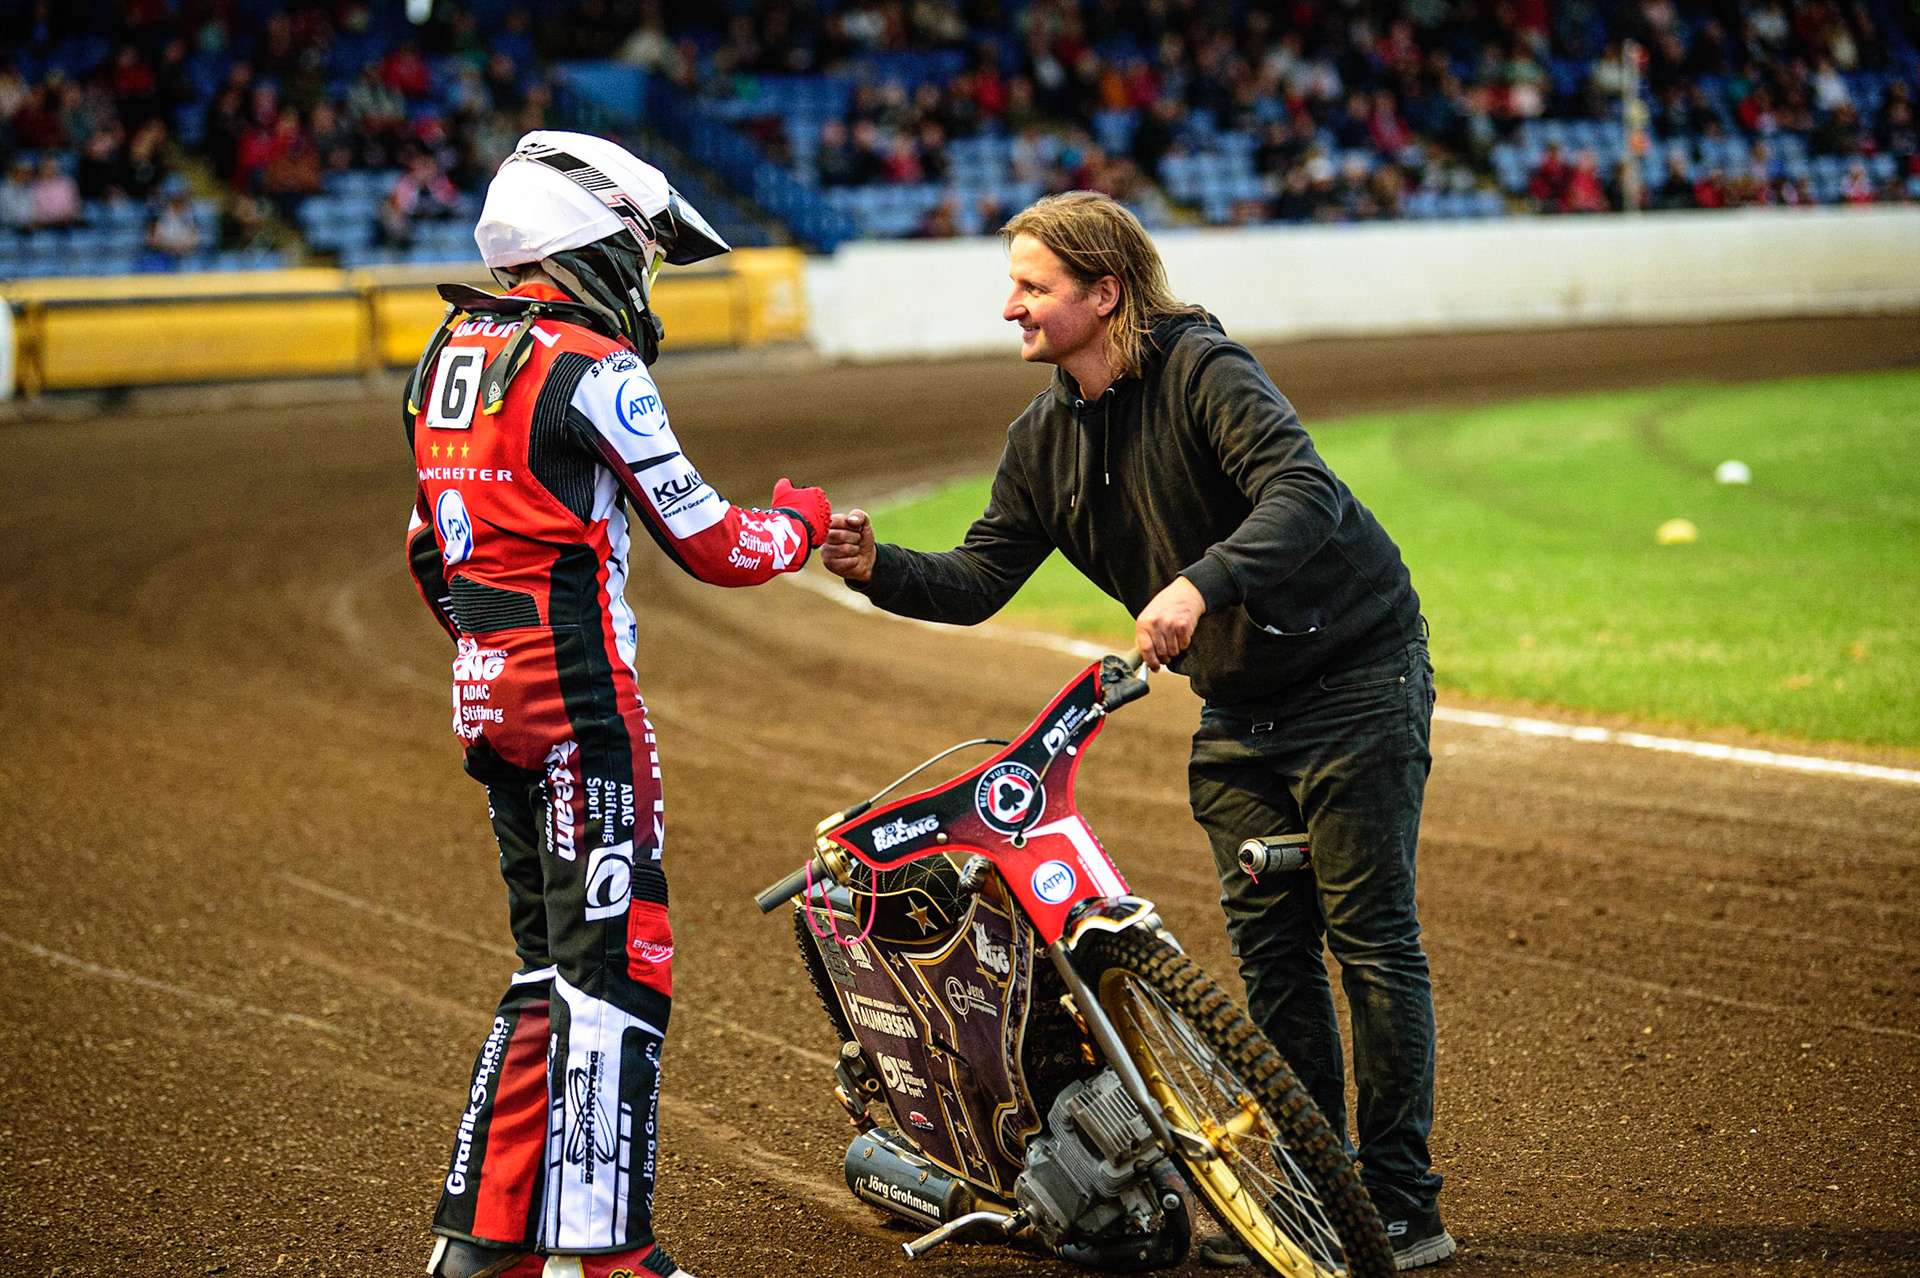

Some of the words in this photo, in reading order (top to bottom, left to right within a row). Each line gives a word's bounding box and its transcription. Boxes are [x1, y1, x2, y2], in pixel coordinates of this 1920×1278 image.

[441, 355, 473, 419] 6
[629, 394, 661, 421] ATPI
[728, 546, 762, 571] Sport
[738, 530, 774, 556] Stiftung
[462, 683, 491, 701] ADAC
[462, 704, 504, 724] Stiftung
[586, 777, 603, 820] Sport
[620, 783, 636, 827] ADAC
[979, 780, 991, 808] BELLE
[989, 767, 1007, 780] VUE
[1009, 766, 1032, 780] ACES
[552, 766, 578, 862] team
[602, 780, 617, 844] Stiftung
[873, 819, 940, 852] RACING
[1042, 871, 1067, 894] ATPI
[597, 1051, 606, 1093] Autohaus
[446, 1015, 505, 1196] GrafikStudio
[642, 1139, 657, 1182] Jörg
[867, 1174, 889, 1199] Jörg
[889, 1184, 940, 1218] Grohmann
